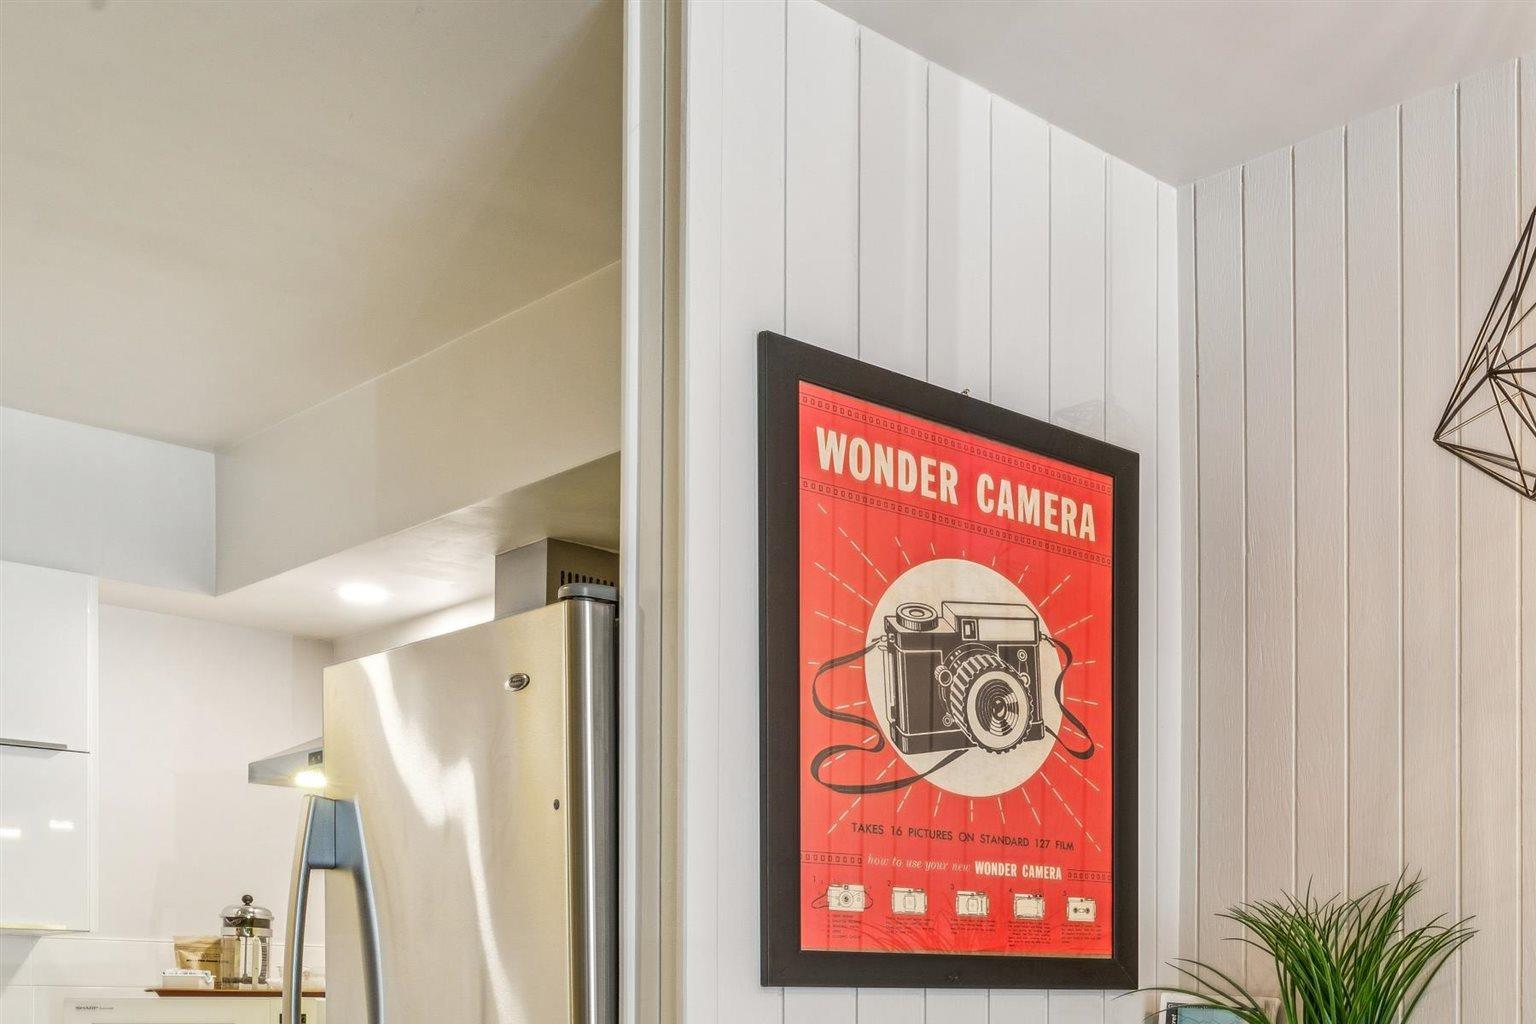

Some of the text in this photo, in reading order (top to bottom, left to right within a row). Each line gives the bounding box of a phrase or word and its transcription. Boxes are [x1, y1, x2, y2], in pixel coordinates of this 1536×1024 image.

[816, 426, 1096, 542] WONDER CAMERA
[851, 822, 1074, 851] TAKES 16 PICTURES ON STANDARD 127 FILM
[867, 853, 1062, 880] how to use your new WONDER CAMERA
